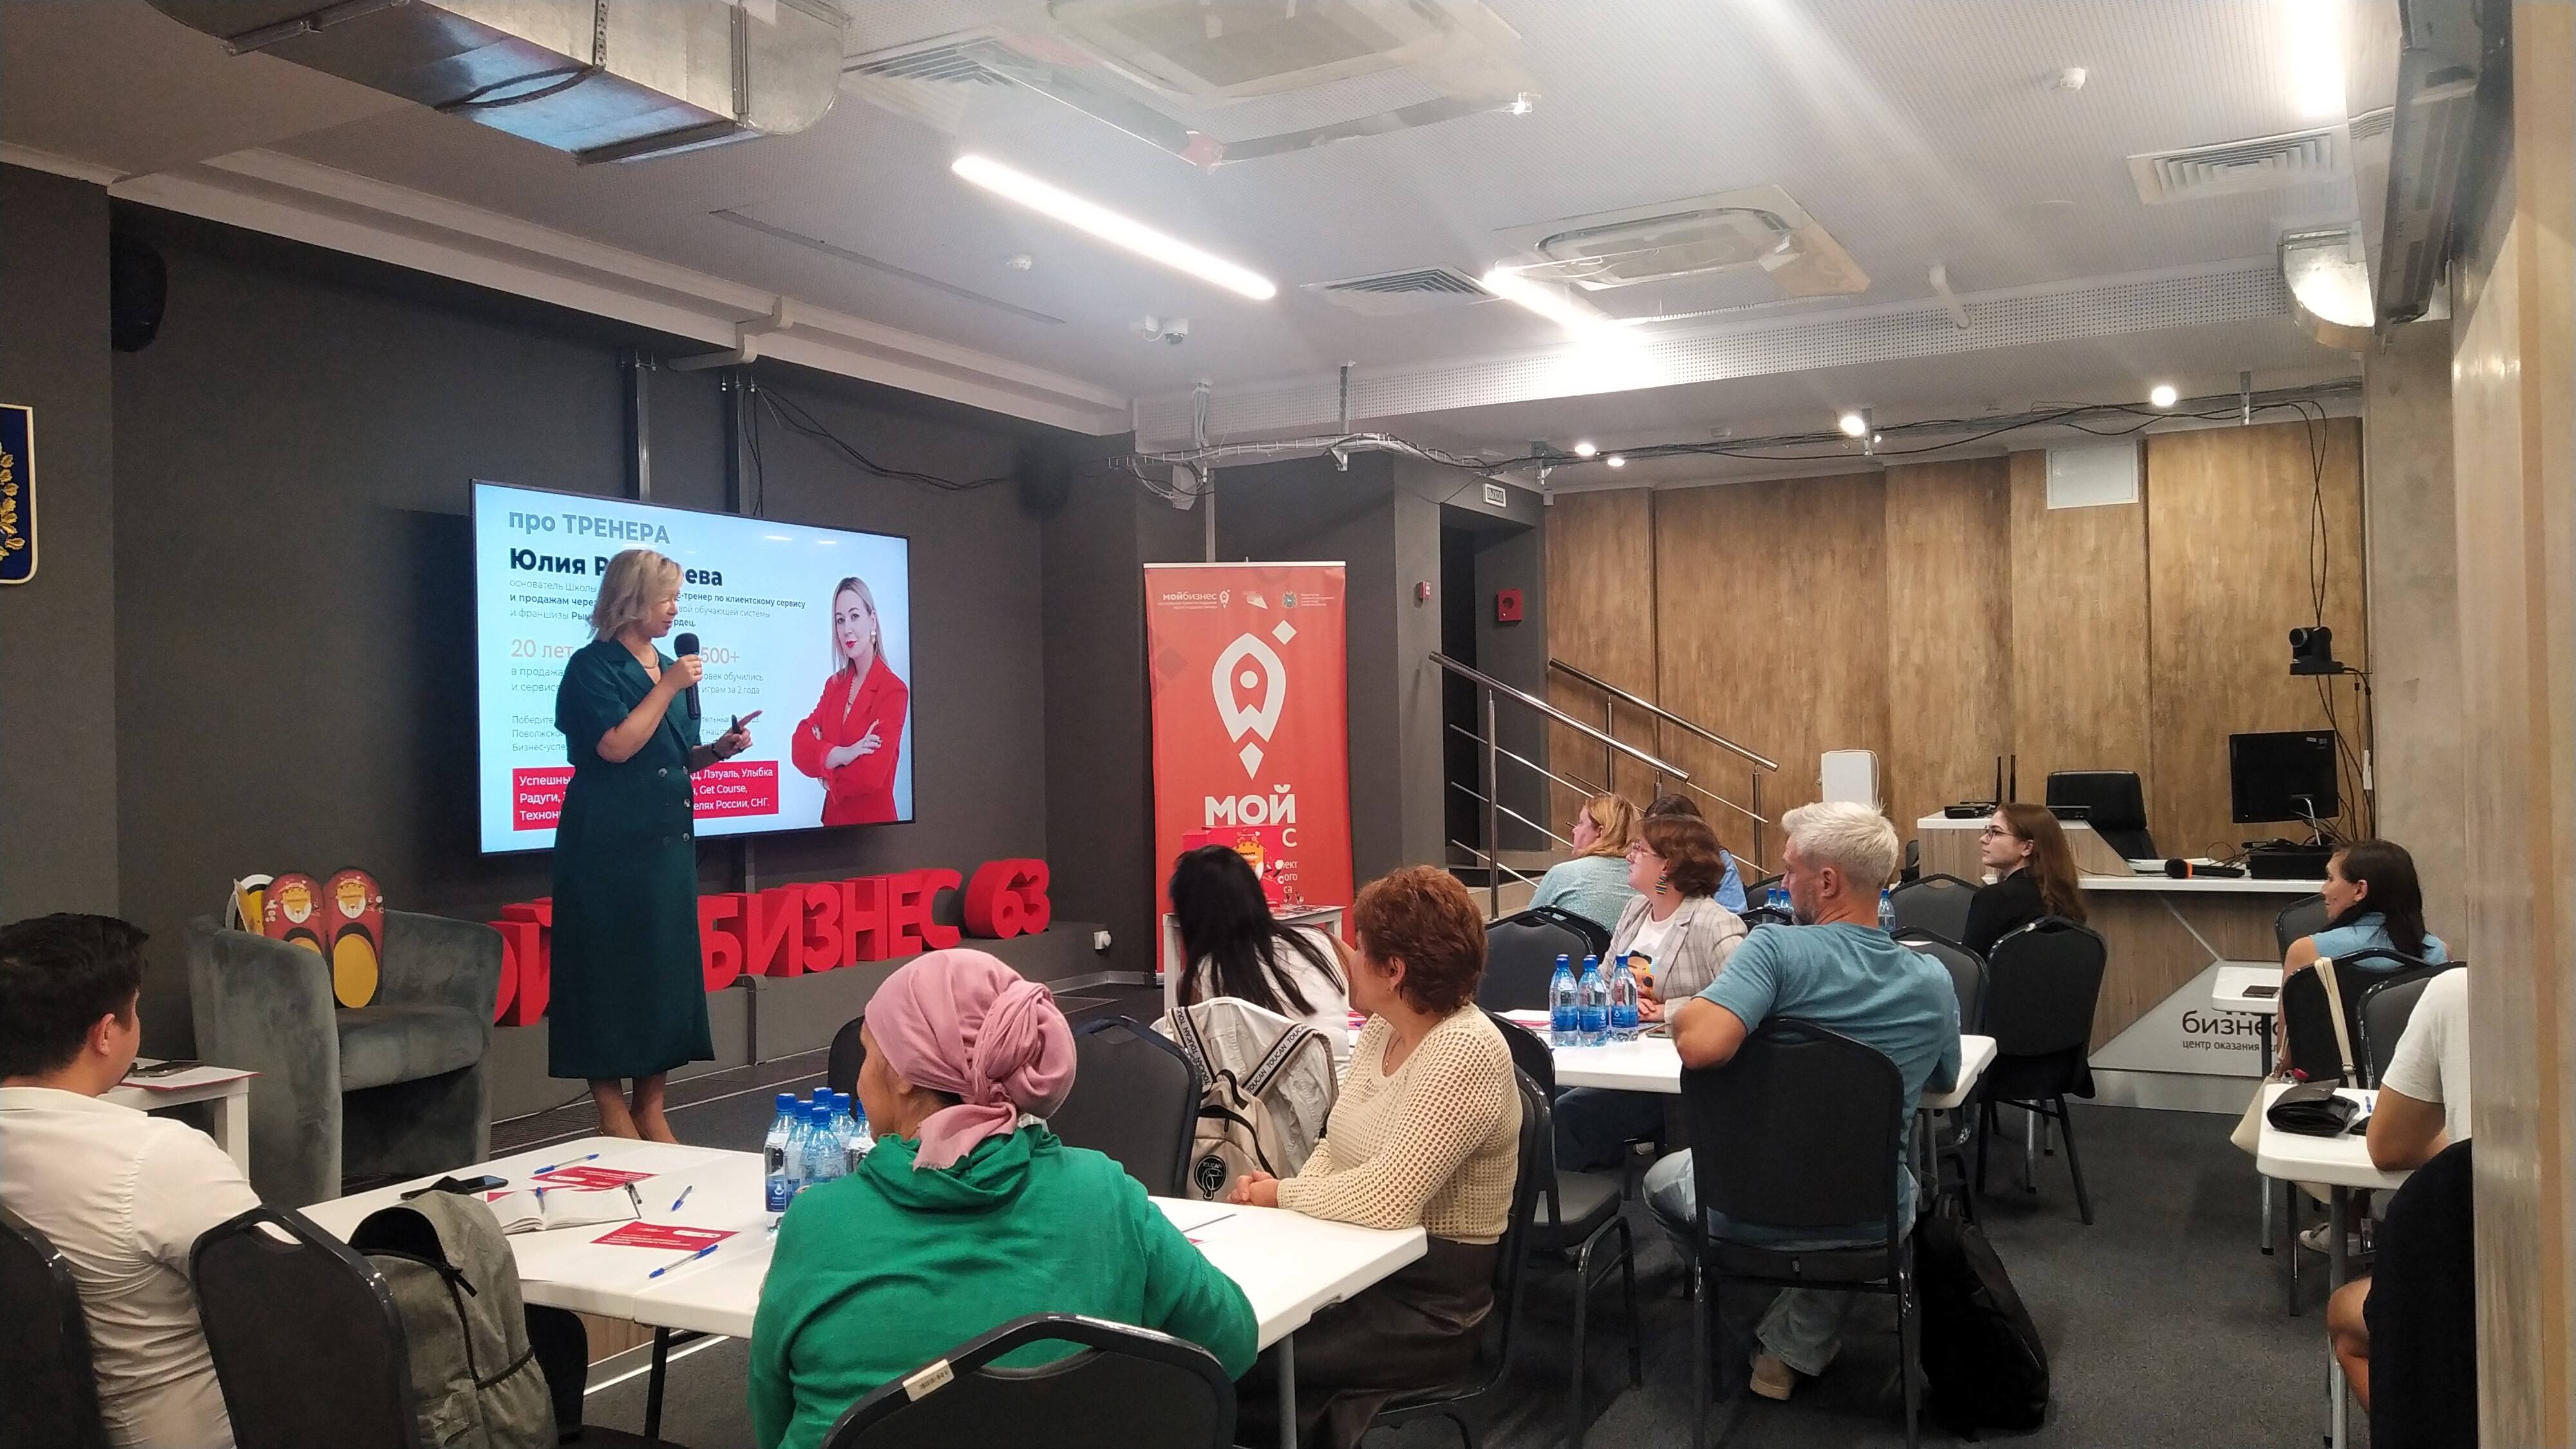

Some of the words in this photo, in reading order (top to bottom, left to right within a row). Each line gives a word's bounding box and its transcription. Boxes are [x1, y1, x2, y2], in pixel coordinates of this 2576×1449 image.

[509, 511, 556, 535] про
[562, 513, 670, 544] ТРЕНЕРА
[510, 547, 586, 575] Юлия
[509, 580, 564, 591] основатель
[565, 583, 597, 592] Школы
[676, 592, 712, 602] с-тренер
[726, 597, 775, 607] клиентскому
[776, 600, 806, 609] сервису
[1163, 591, 1217, 601] мойбизнес
[519, 595, 569, 605] продажам
[695, 606, 739, 616] обучающей
[740, 610, 770, 618] системы
[519, 609, 569, 619] франшизы
[674, 619, 696, 627] рдец.
[511, 639, 536, 658] 20
[541, 645, 574, 658] лет
[520, 668, 565, 677] продажа
[724, 672, 763, 682] обучились
[702, 687, 726, 695] играм
[512, 715, 554, 725] Победите
[512, 729, 563, 738] Поволжско
[512, 743, 567, 753] Бизнес-успе
[519, 776, 571, 786] Успешны
[703, 770, 740, 781] Лэтуаль,
[741, 767, 773, 778] Улыбка
[700, 785, 715, 795] Get
[717, 785, 748, 794] Course,
[520, 793, 561, 805] Радуги,
[693, 801, 714, 810] елях
[716, 800, 749, 810] России,
[751, 798, 770, 807] СНГ.
[1204, 784, 1296, 826] МОЙ
[1283, 861, 1298, 869] ект
[1284, 873, 1298, 881] ого
[698, 868, 963, 992] БИЗНЕС
[969, 858, 1050, 939] 63
[1183, 1027, 1198, 1054] TOUCAN
[2183, 1040, 2211, 1051] центр
[2214, 1042, 2260, 1051] оказания
[1266, 1044, 1287, 1069] TOUCAN
[1246, 1069, 1267, 1093] TOUCAN
